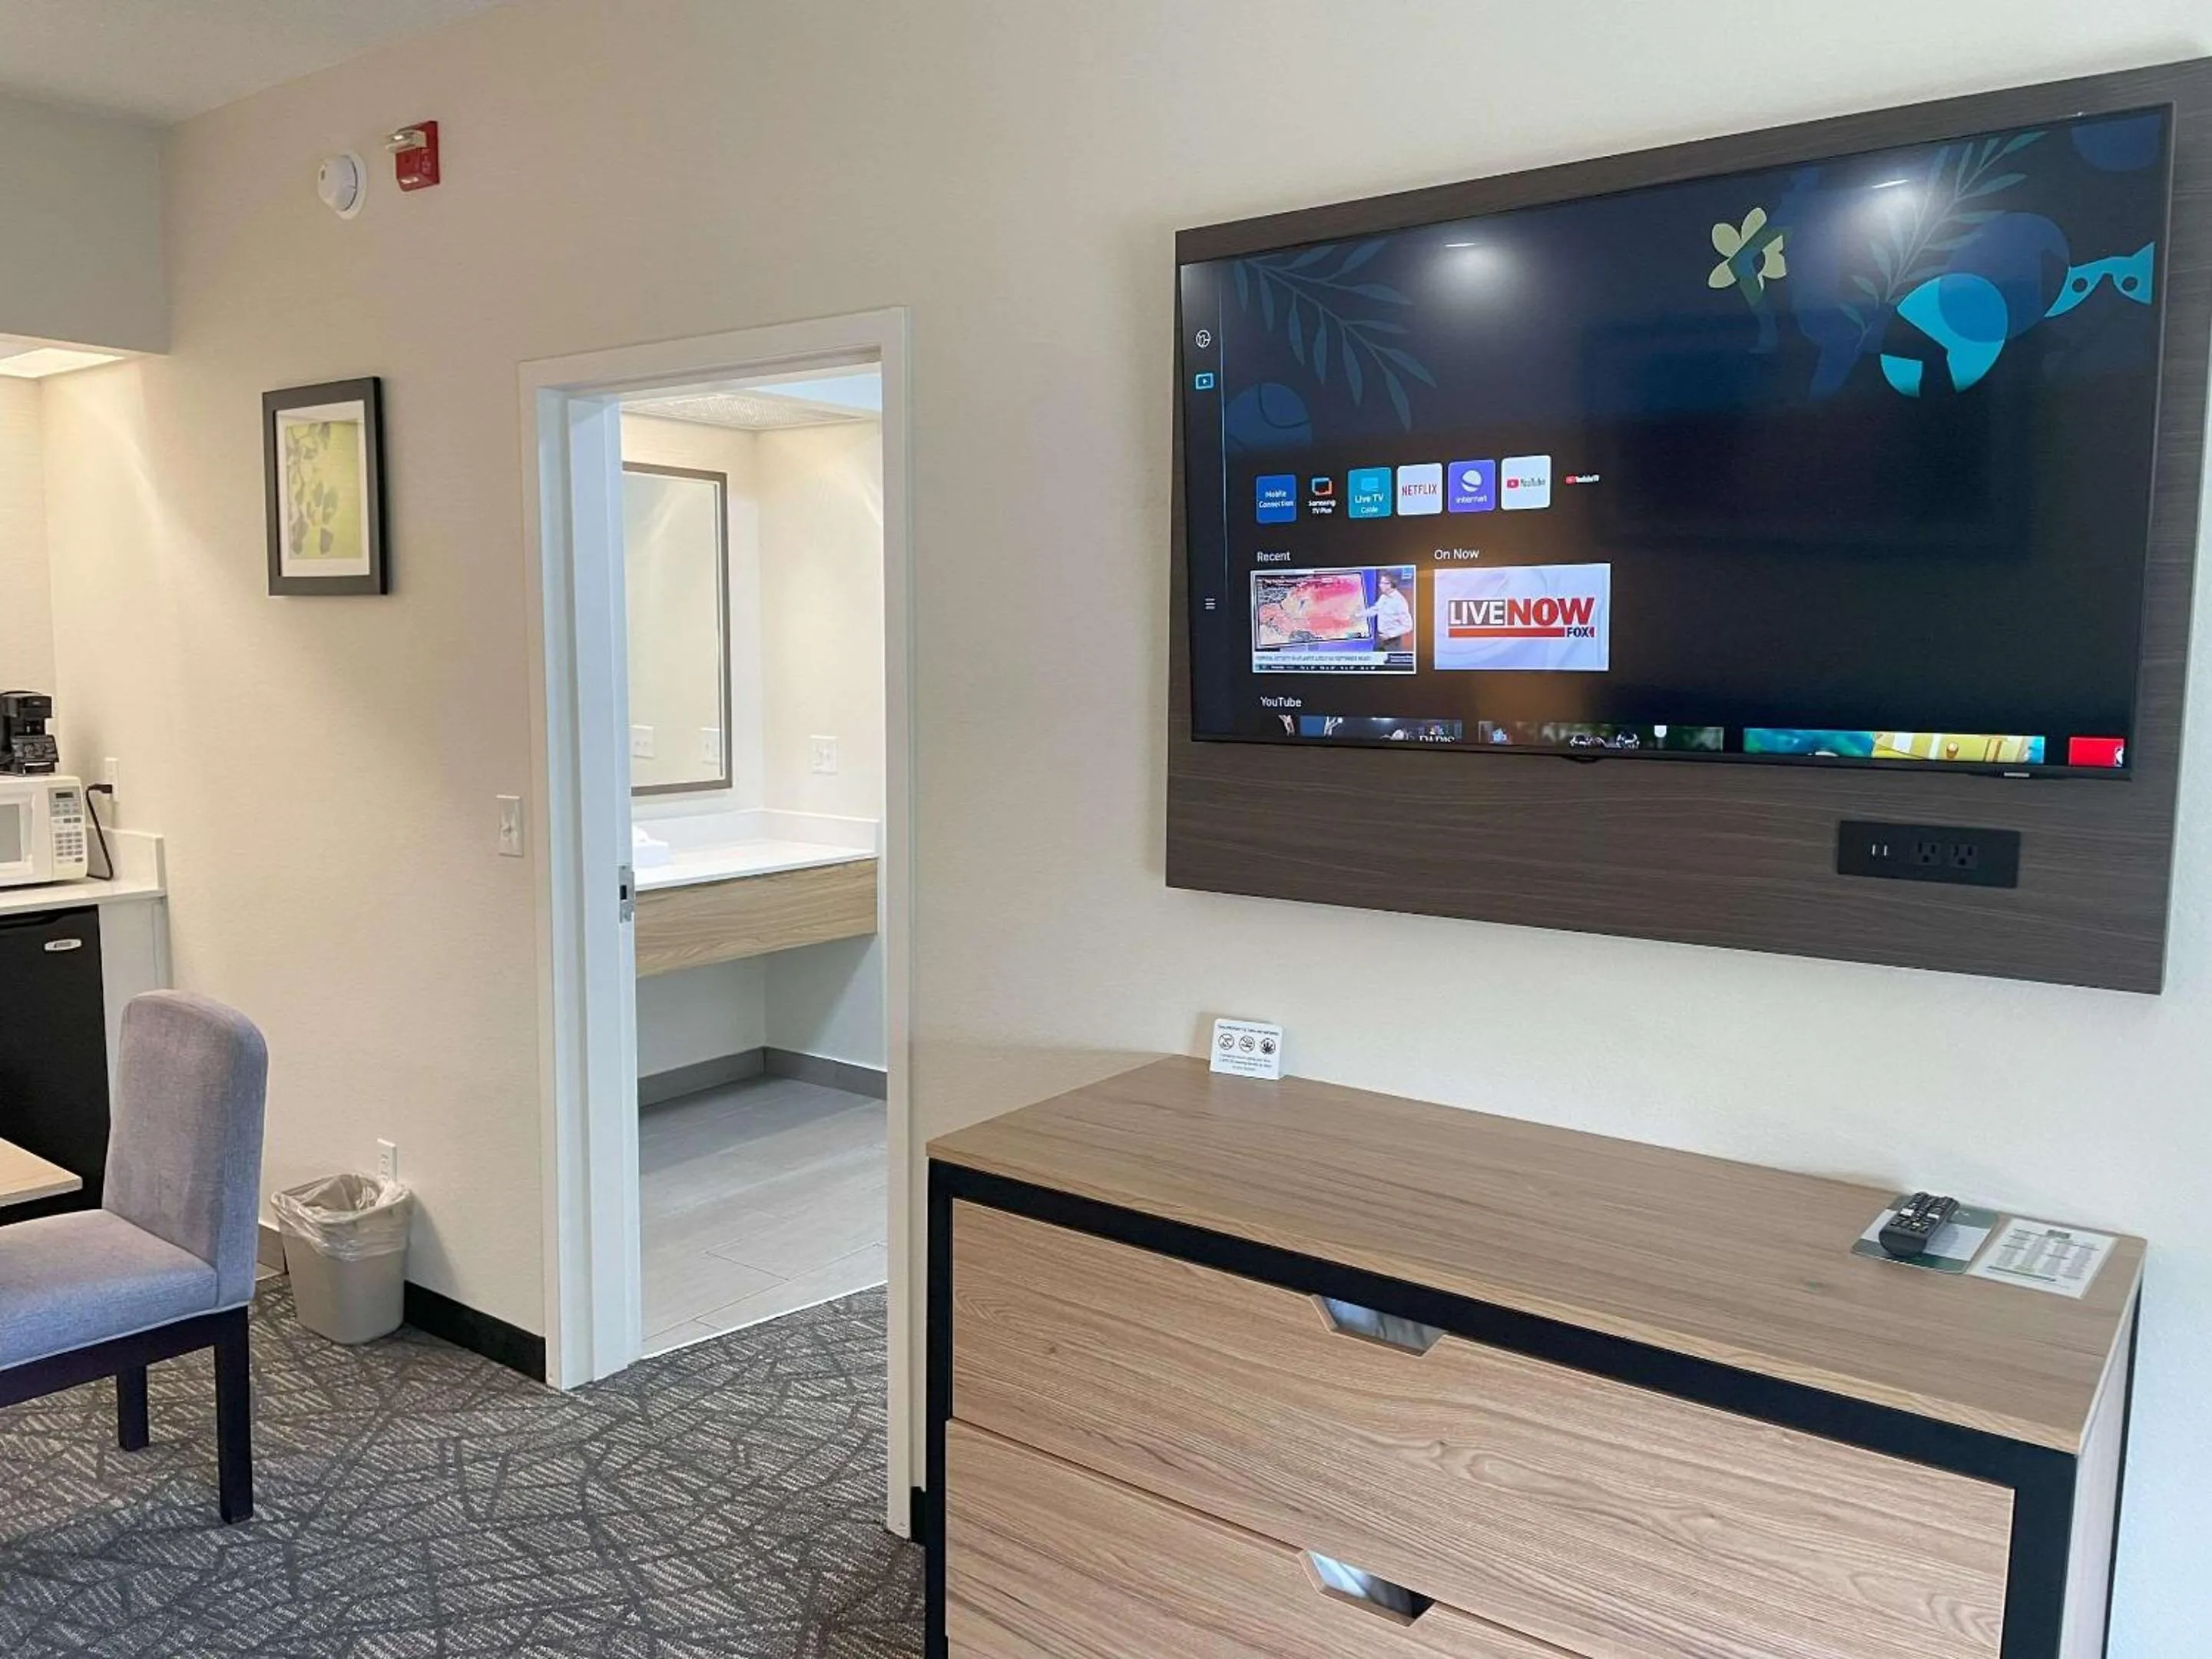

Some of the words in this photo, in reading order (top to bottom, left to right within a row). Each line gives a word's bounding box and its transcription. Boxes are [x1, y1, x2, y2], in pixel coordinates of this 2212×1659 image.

[1520, 478, 1546, 488] YouTube
[1265, 489, 1286, 498] Mobile
[1402, 484, 1437, 496] NETFLIX
[1259, 500, 1294, 508] Connection
[1355, 495, 1371, 504] Live
[1372, 493, 1384, 502] TV
[1257, 551, 1290, 562] Recent
[1434, 549, 1450, 560] On
[1453, 548, 1480, 559] Now
[1260, 696, 1303, 707] YouTube
